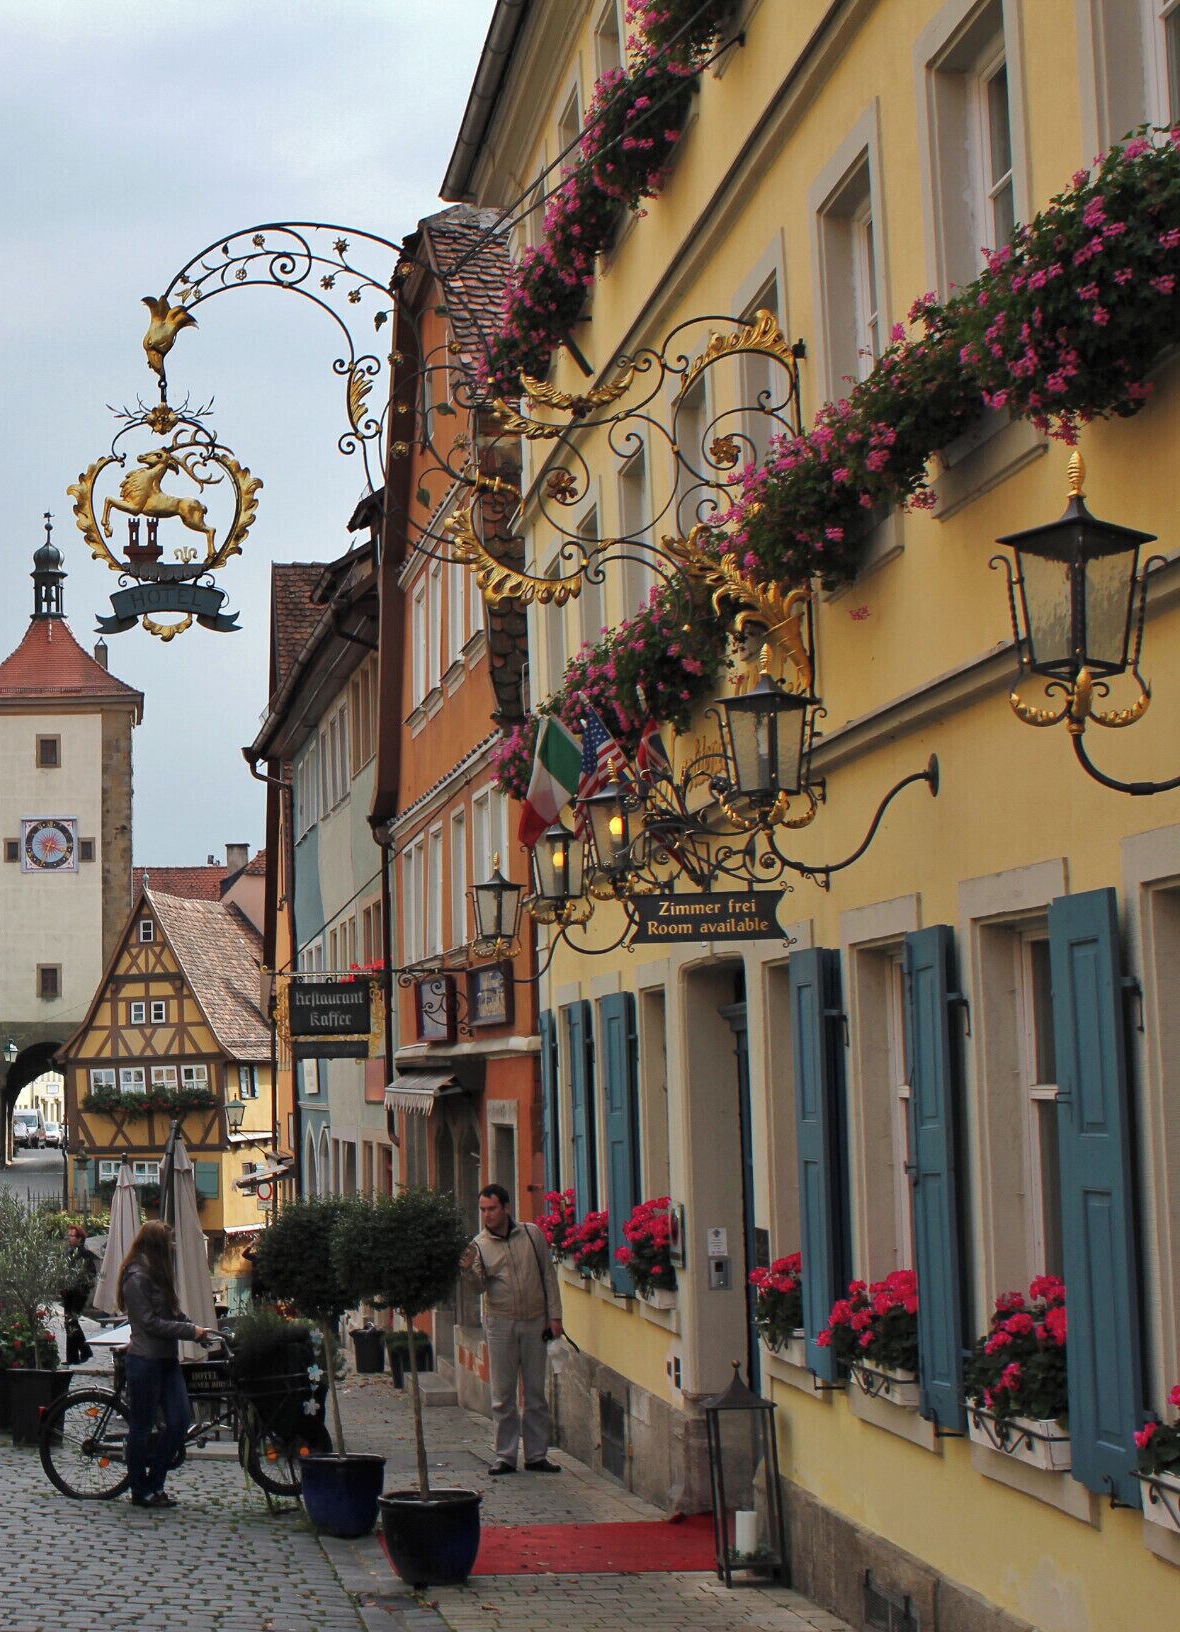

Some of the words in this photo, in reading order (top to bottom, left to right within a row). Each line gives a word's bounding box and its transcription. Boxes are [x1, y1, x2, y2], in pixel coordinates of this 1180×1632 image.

[128, 588, 202, 609] HOTEL
[658, 901, 721, 916] Zimmer
[728, 899, 756, 913] frei
[647, 921, 692, 935] Room
[699, 917, 769, 933] available
[191, 1371, 218, 1381] HOTEL
